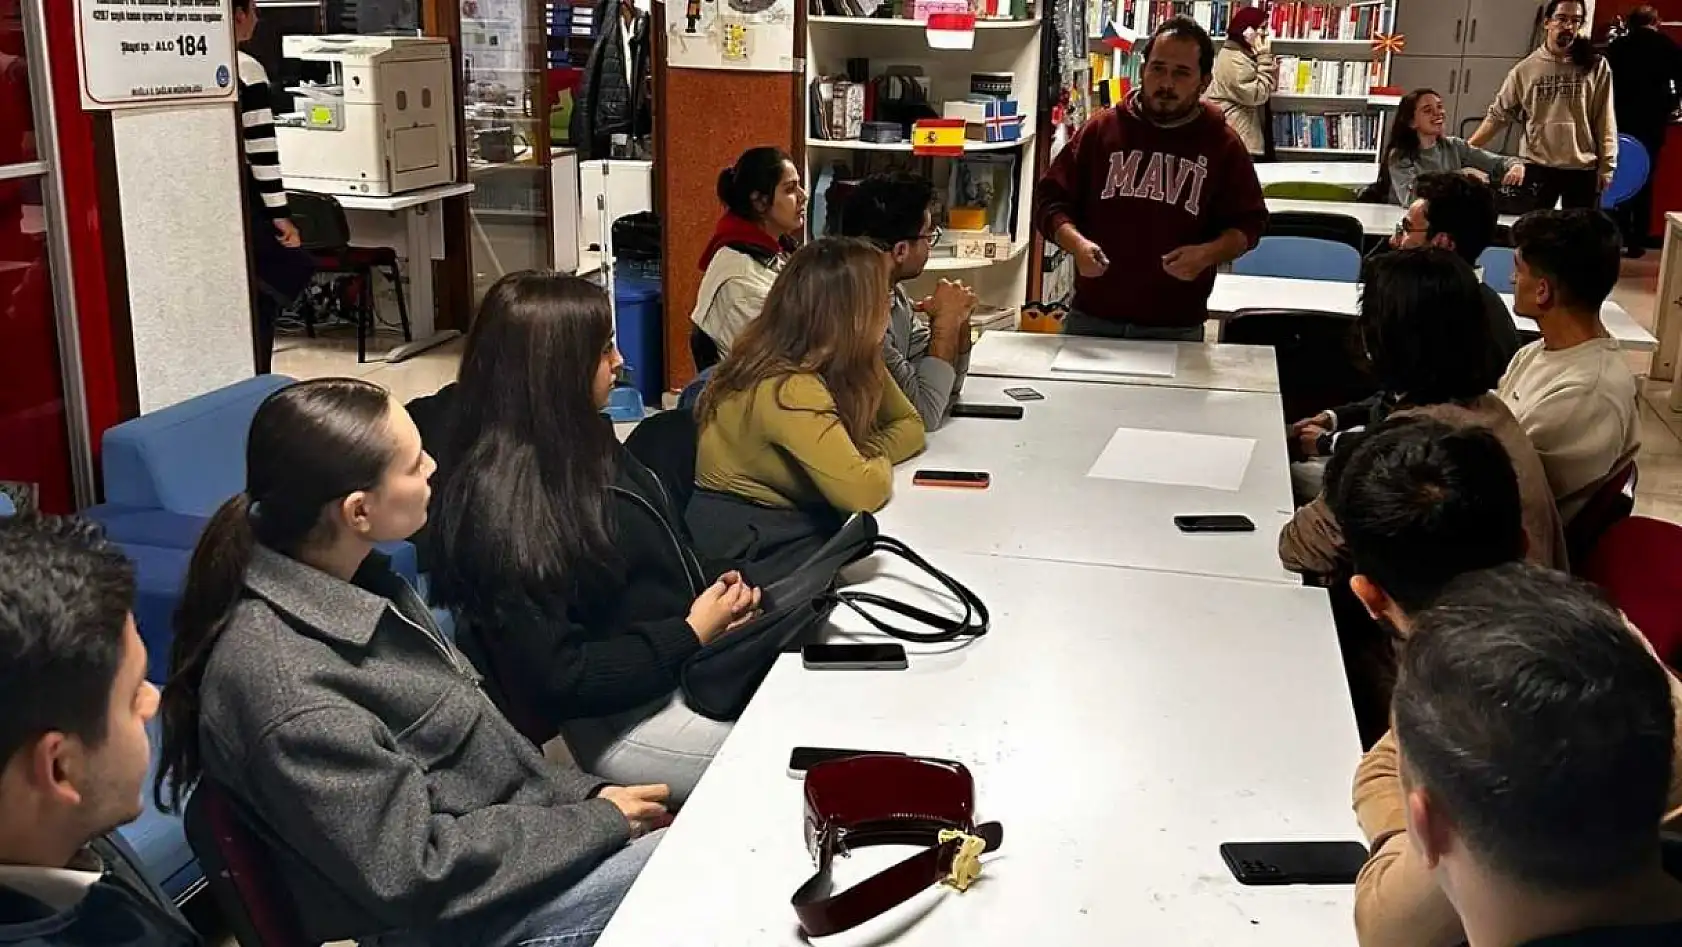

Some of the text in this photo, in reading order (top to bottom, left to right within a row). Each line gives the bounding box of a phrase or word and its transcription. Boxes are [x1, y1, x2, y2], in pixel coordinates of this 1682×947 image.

[155, 40, 174, 52] ALO
[176, 35, 207, 56] 184
[1100, 149, 1209, 216] MAVİ
